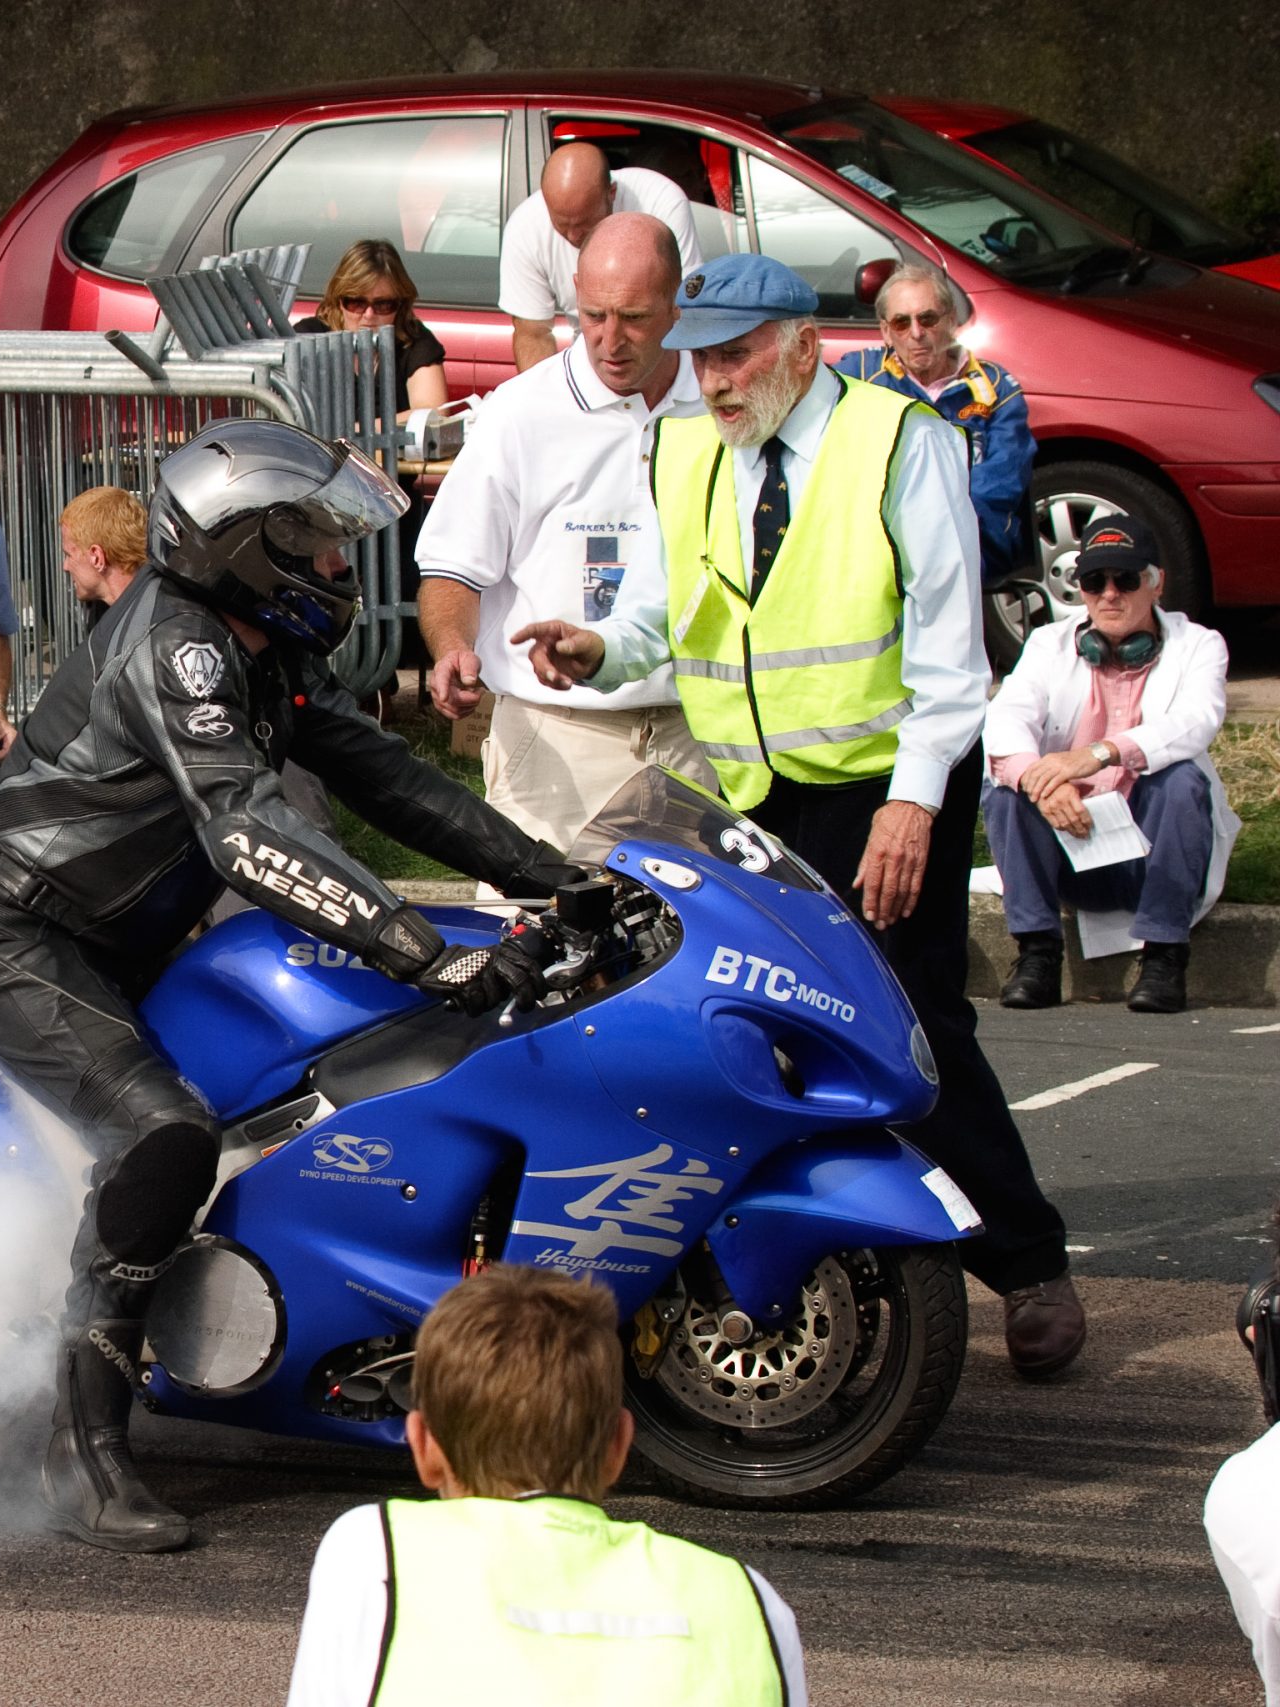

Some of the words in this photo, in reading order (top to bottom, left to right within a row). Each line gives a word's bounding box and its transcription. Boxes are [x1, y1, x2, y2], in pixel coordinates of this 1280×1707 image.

[221, 832, 380, 920] ARLEN
[231, 857, 351, 927] NESS
[705, 945, 856, 1023] BTC-MOTO
[299, 1169, 320, 1180] DYNO
[321, 1171, 346, 1182] SPEED
[346, 1174, 407, 1187] DEVELOPMENTS
[534, 1248, 652, 1274] Hayabusa
